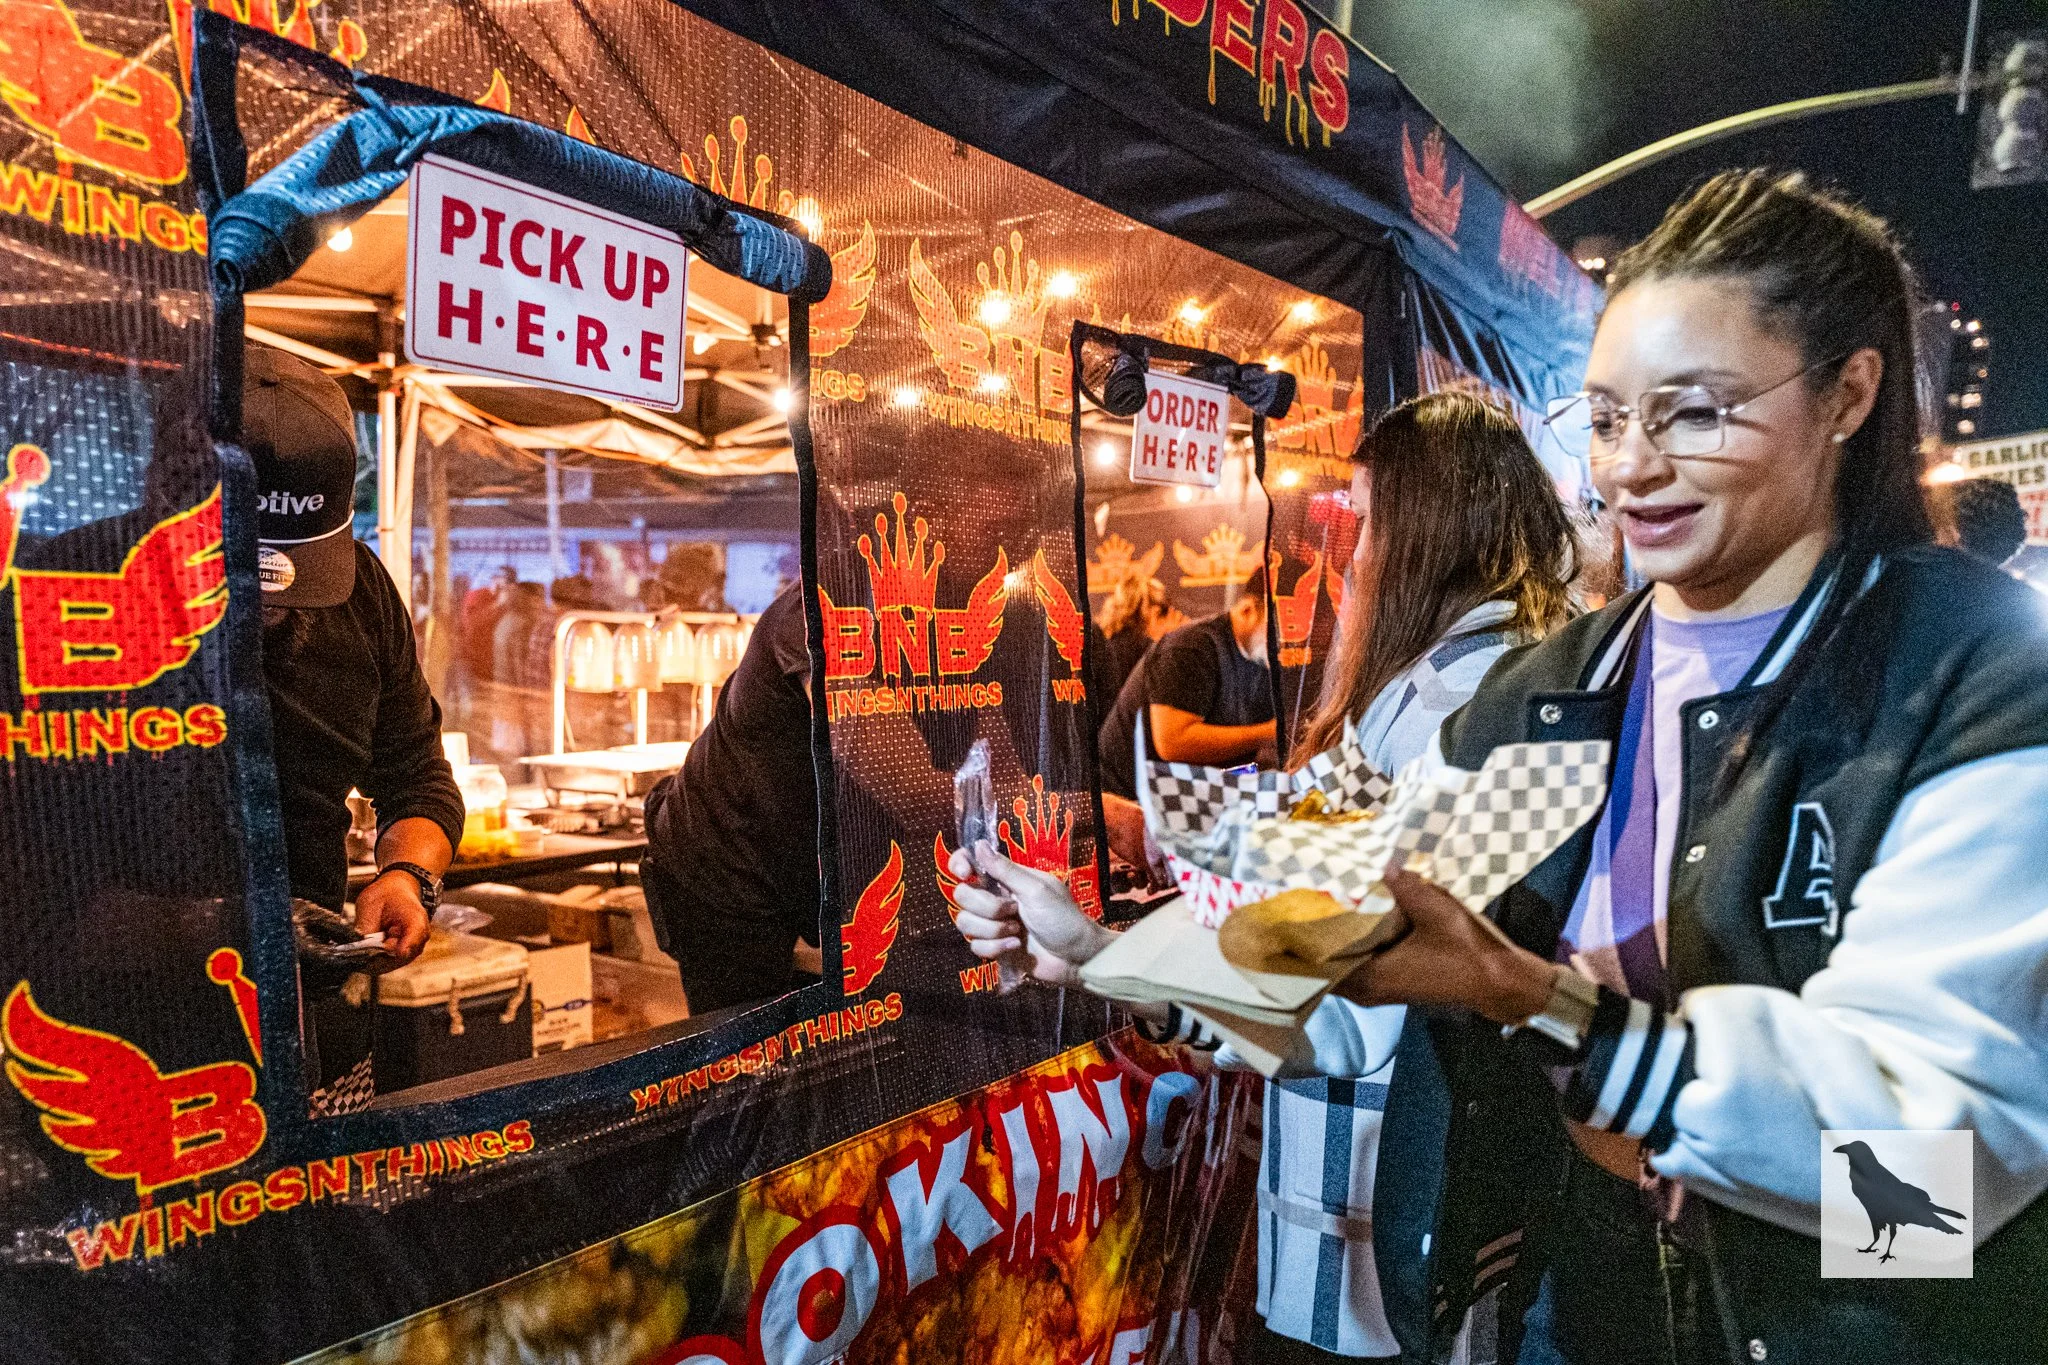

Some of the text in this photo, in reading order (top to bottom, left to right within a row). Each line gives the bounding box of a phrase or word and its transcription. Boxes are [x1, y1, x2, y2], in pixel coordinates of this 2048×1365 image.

[439, 195, 670, 309] PICK UP
[1147, 388, 1219, 434] ORDER
[1763, 802, 1839, 937] A
[630, 992, 904, 1113] WINGSNTHINGS
[66, 1120, 536, 1272] WINGSNTHINGS
